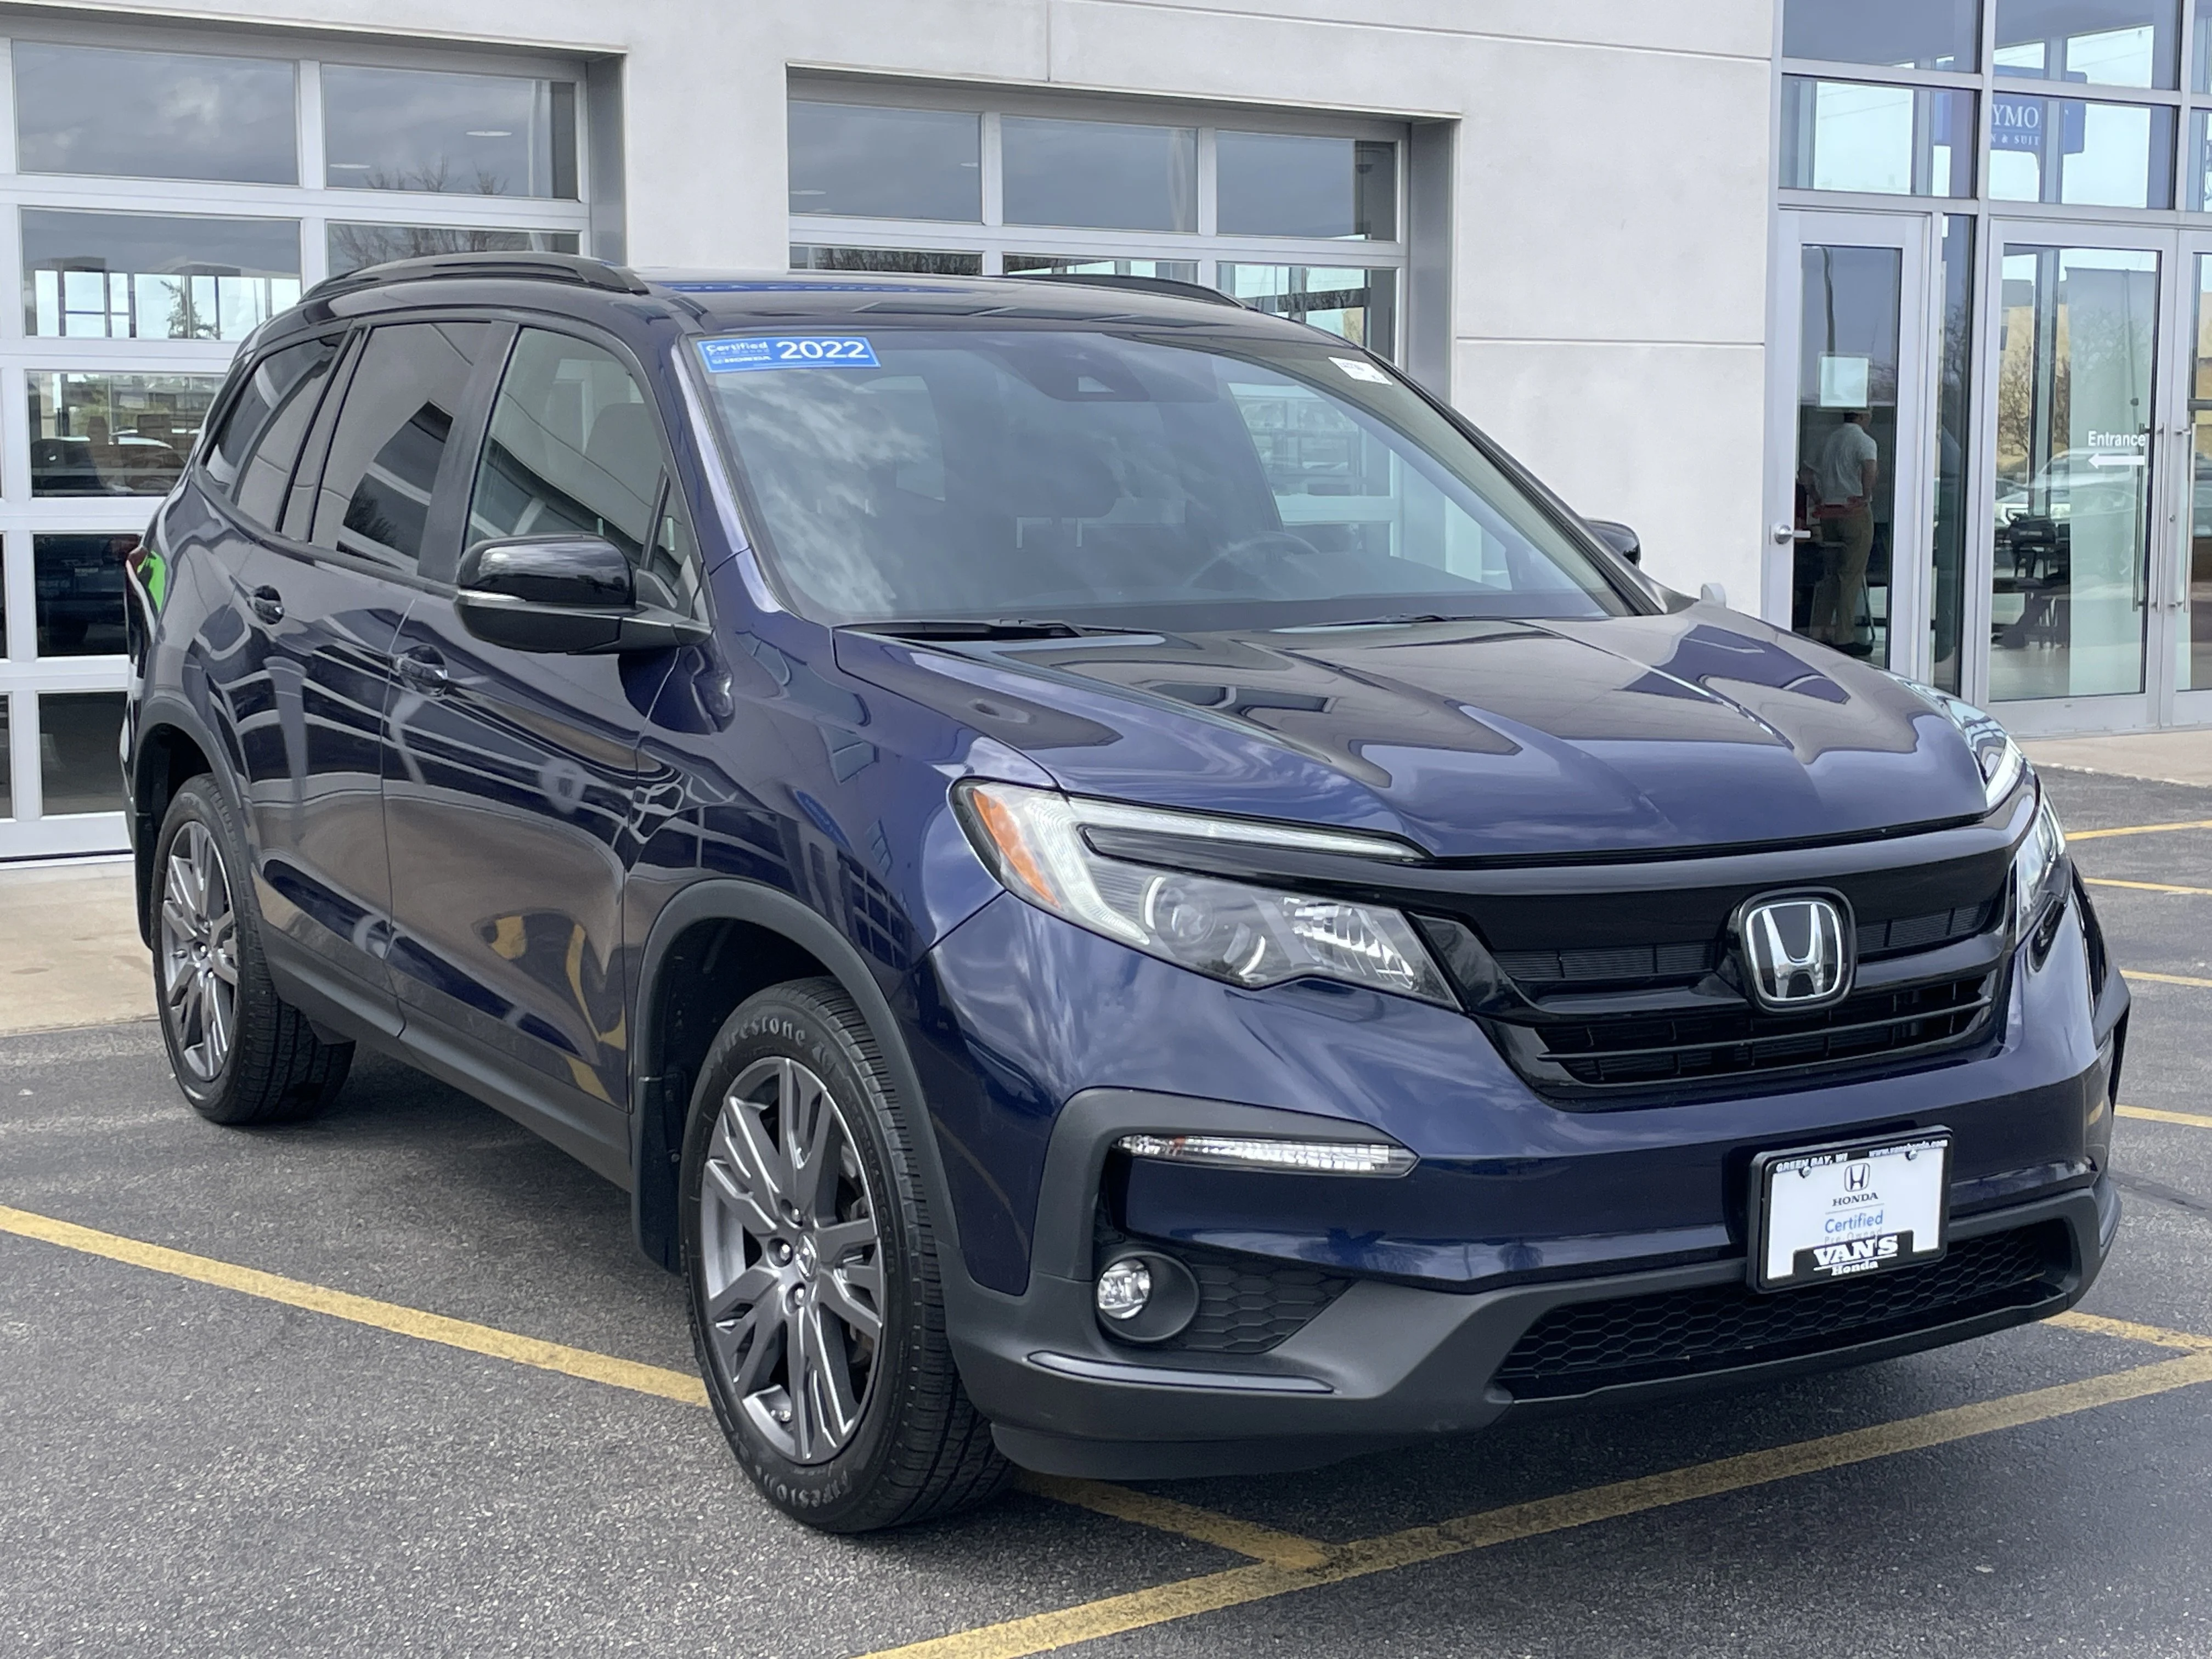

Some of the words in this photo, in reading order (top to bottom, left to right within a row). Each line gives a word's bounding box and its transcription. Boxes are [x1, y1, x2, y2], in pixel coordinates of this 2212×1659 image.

[1992, 104, 2042, 128] YMO
[2014, 135, 2040, 145] SUIT
[706, 341, 768, 352] Certified
[776, 341, 870, 359] 2022
[2088, 430, 2146, 447] Entrance
[1832, 1192, 1878, 1206] HONDA
[1825, 1209, 1883, 1233] Certified
[1831, 1260, 1878, 1276] Honda
